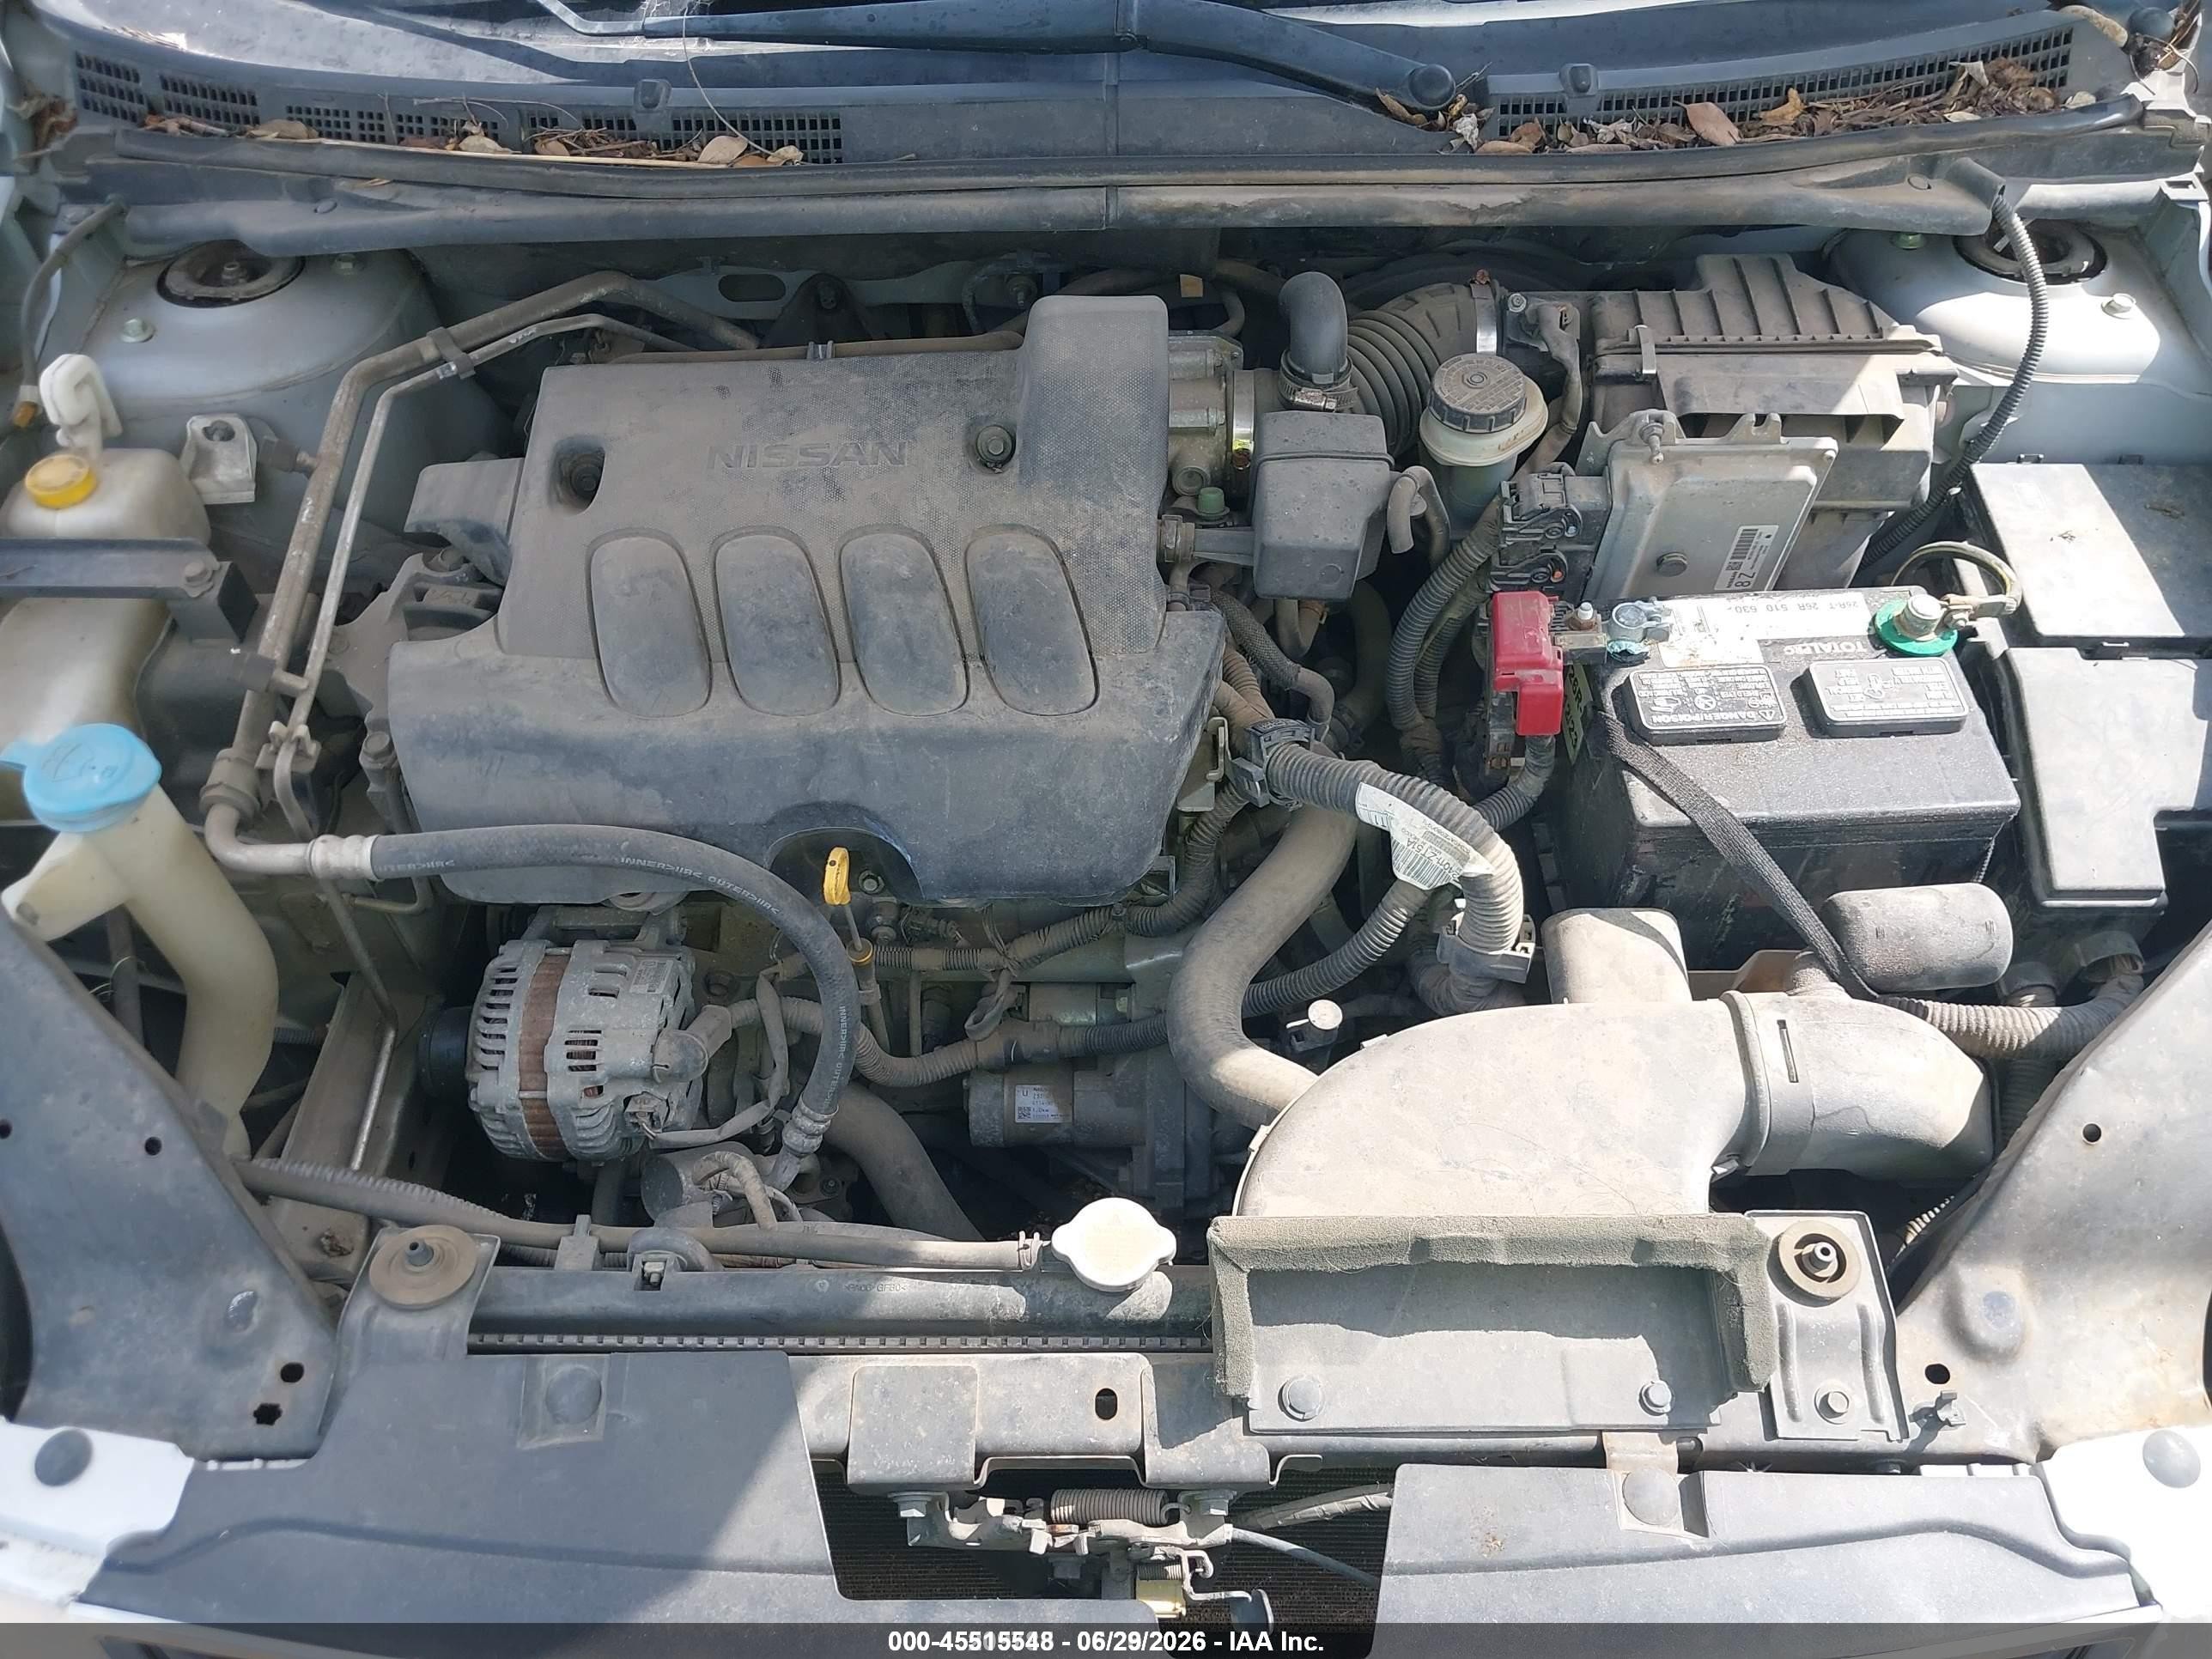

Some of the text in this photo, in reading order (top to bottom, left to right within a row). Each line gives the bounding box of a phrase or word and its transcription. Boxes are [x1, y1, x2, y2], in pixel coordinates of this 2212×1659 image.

[707, 441, 909, 469] NISSAN
[1734, 605, 1758, 613] 630
[1765, 603, 1789, 611] 510
[1796, 602, 1819, 611] 26R
[1650, 709, 1756, 723] DANGER/POISON
